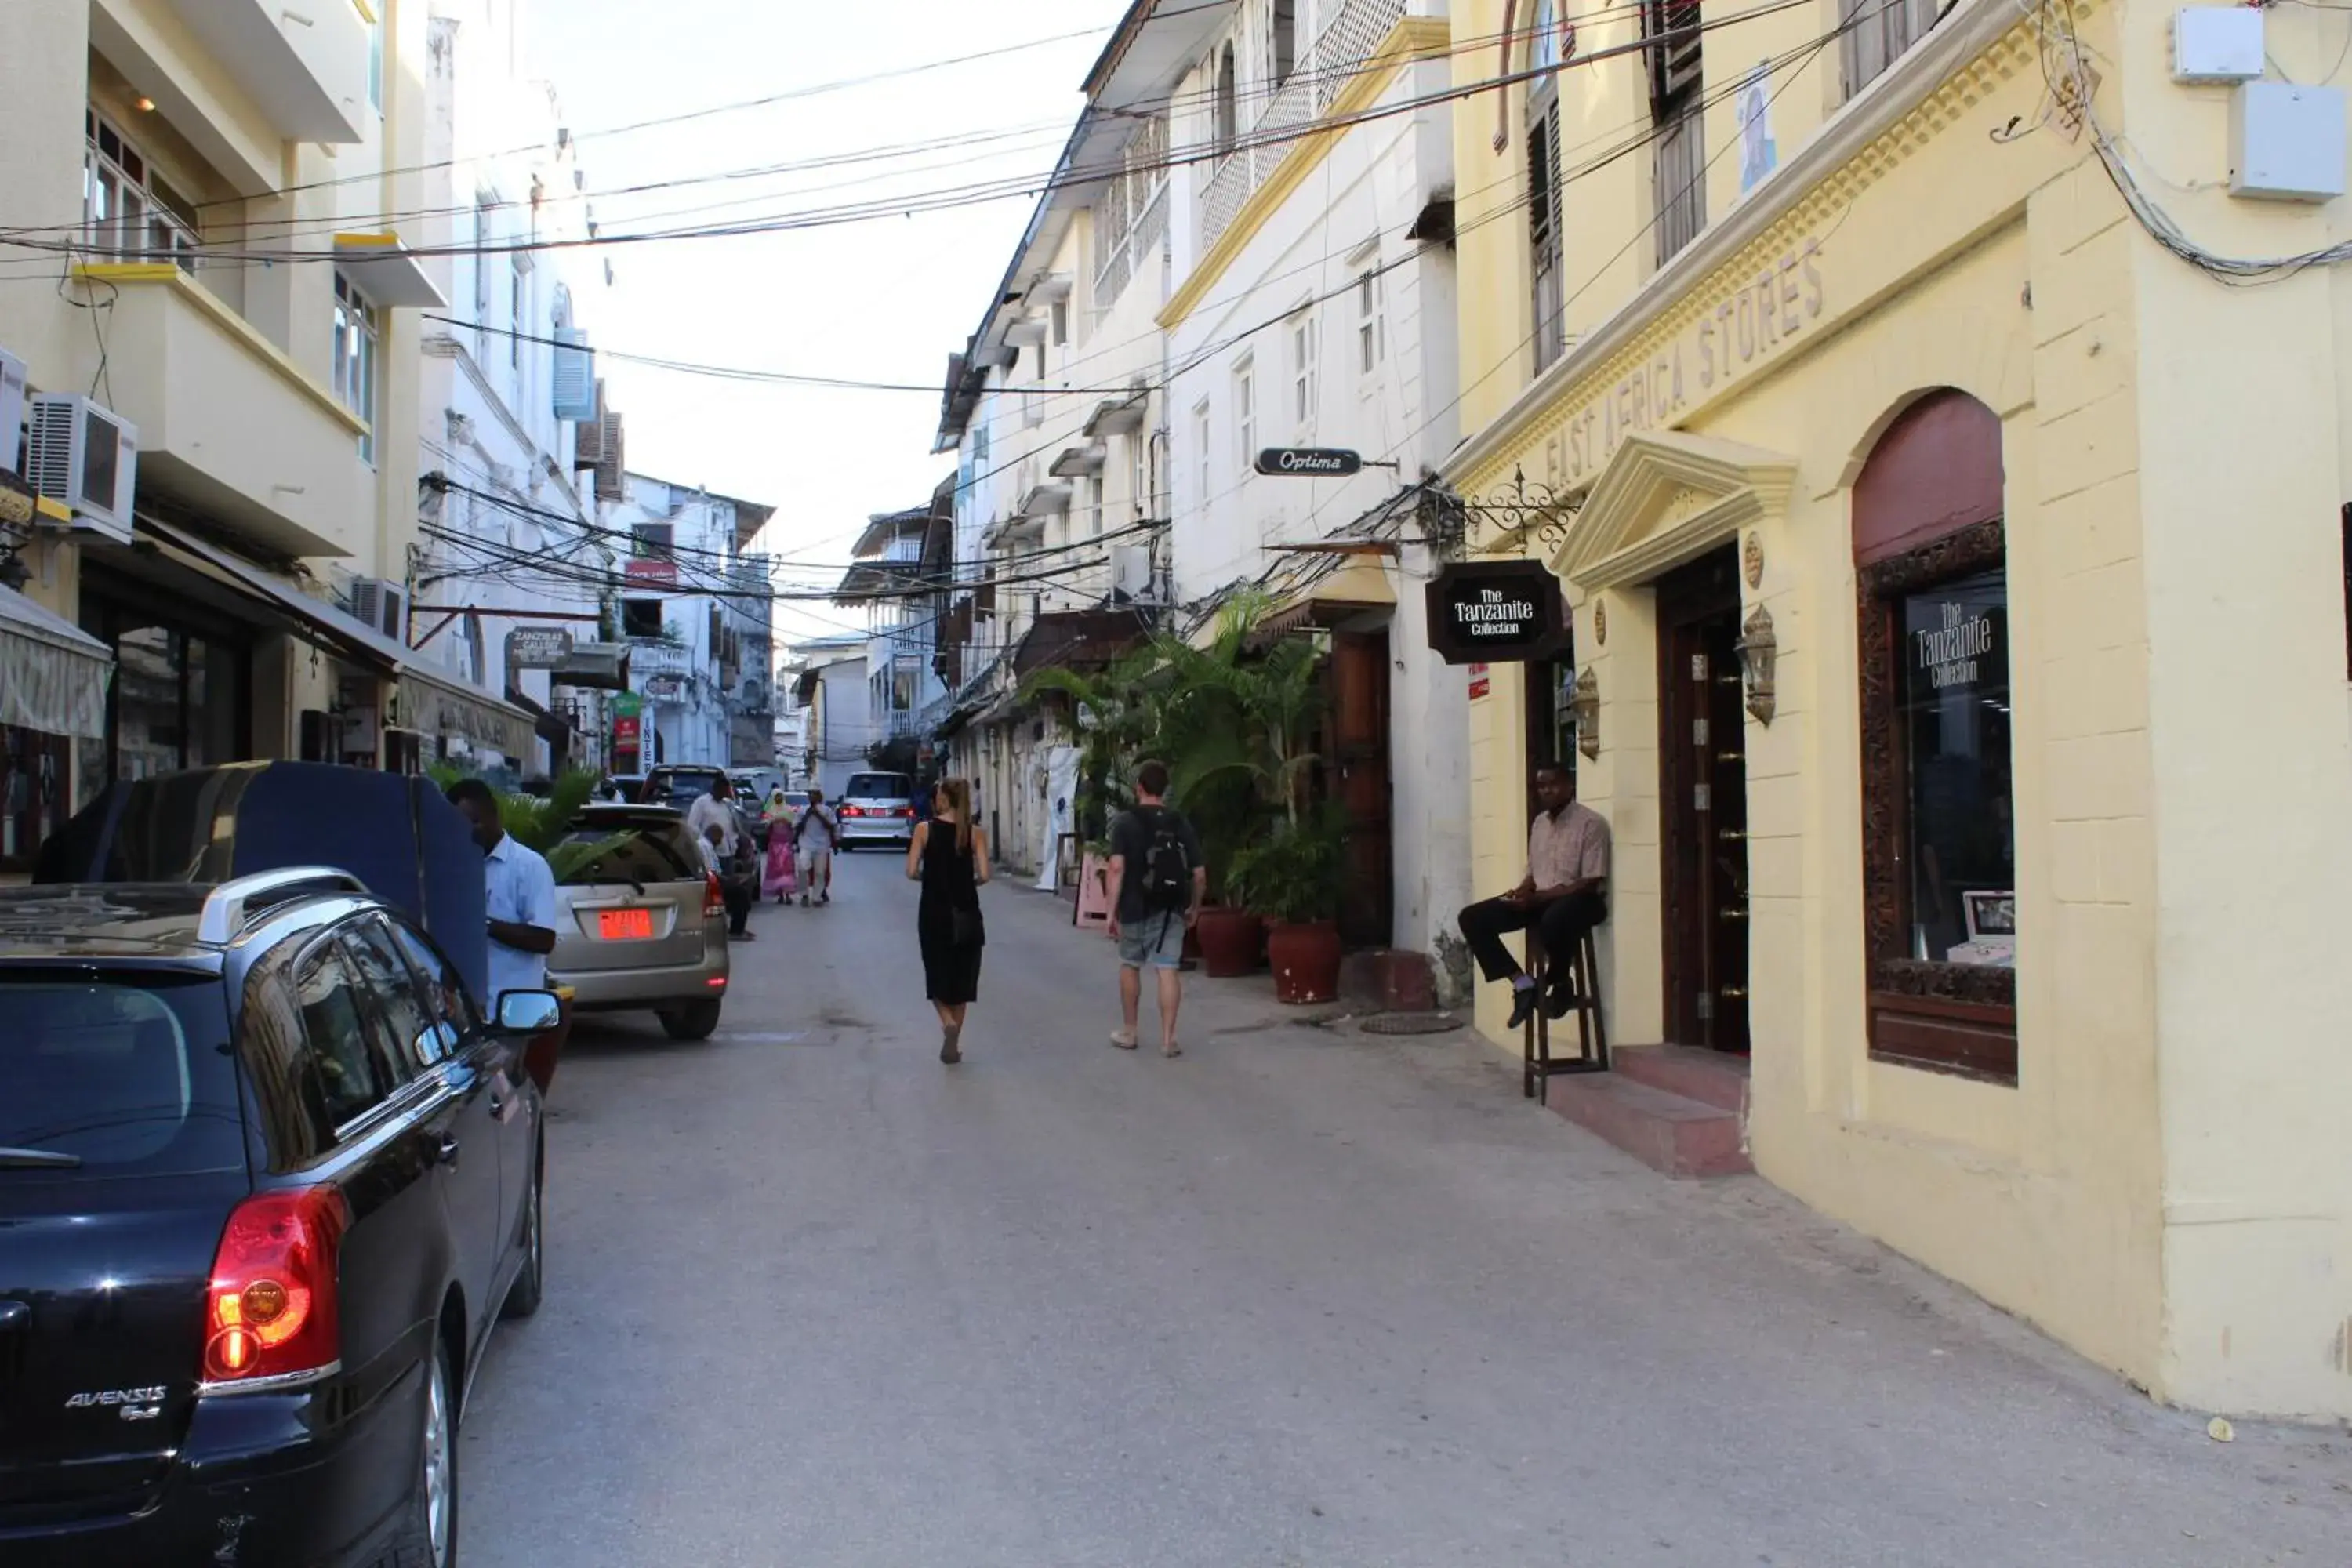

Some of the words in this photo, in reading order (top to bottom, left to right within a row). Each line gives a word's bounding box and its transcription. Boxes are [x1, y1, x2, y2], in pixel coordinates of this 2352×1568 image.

[1546, 408, 1596, 492] EAST
[1604, 340, 1686, 456] AFRICA
[1698, 236, 1824, 390] STORES
[1279, 451, 1341, 470] Optima
[1480, 589, 1503, 603] The
[1454, 599, 1534, 622] Tanzanite
[1941, 601, 1961, 629] The
[1472, 622, 1519, 635] Collection
[1917, 615, 1991, 669] Tanzanite
[1931, 660, 1977, 688] Collection
[64, 1385, 167, 1408] AVENSIS
